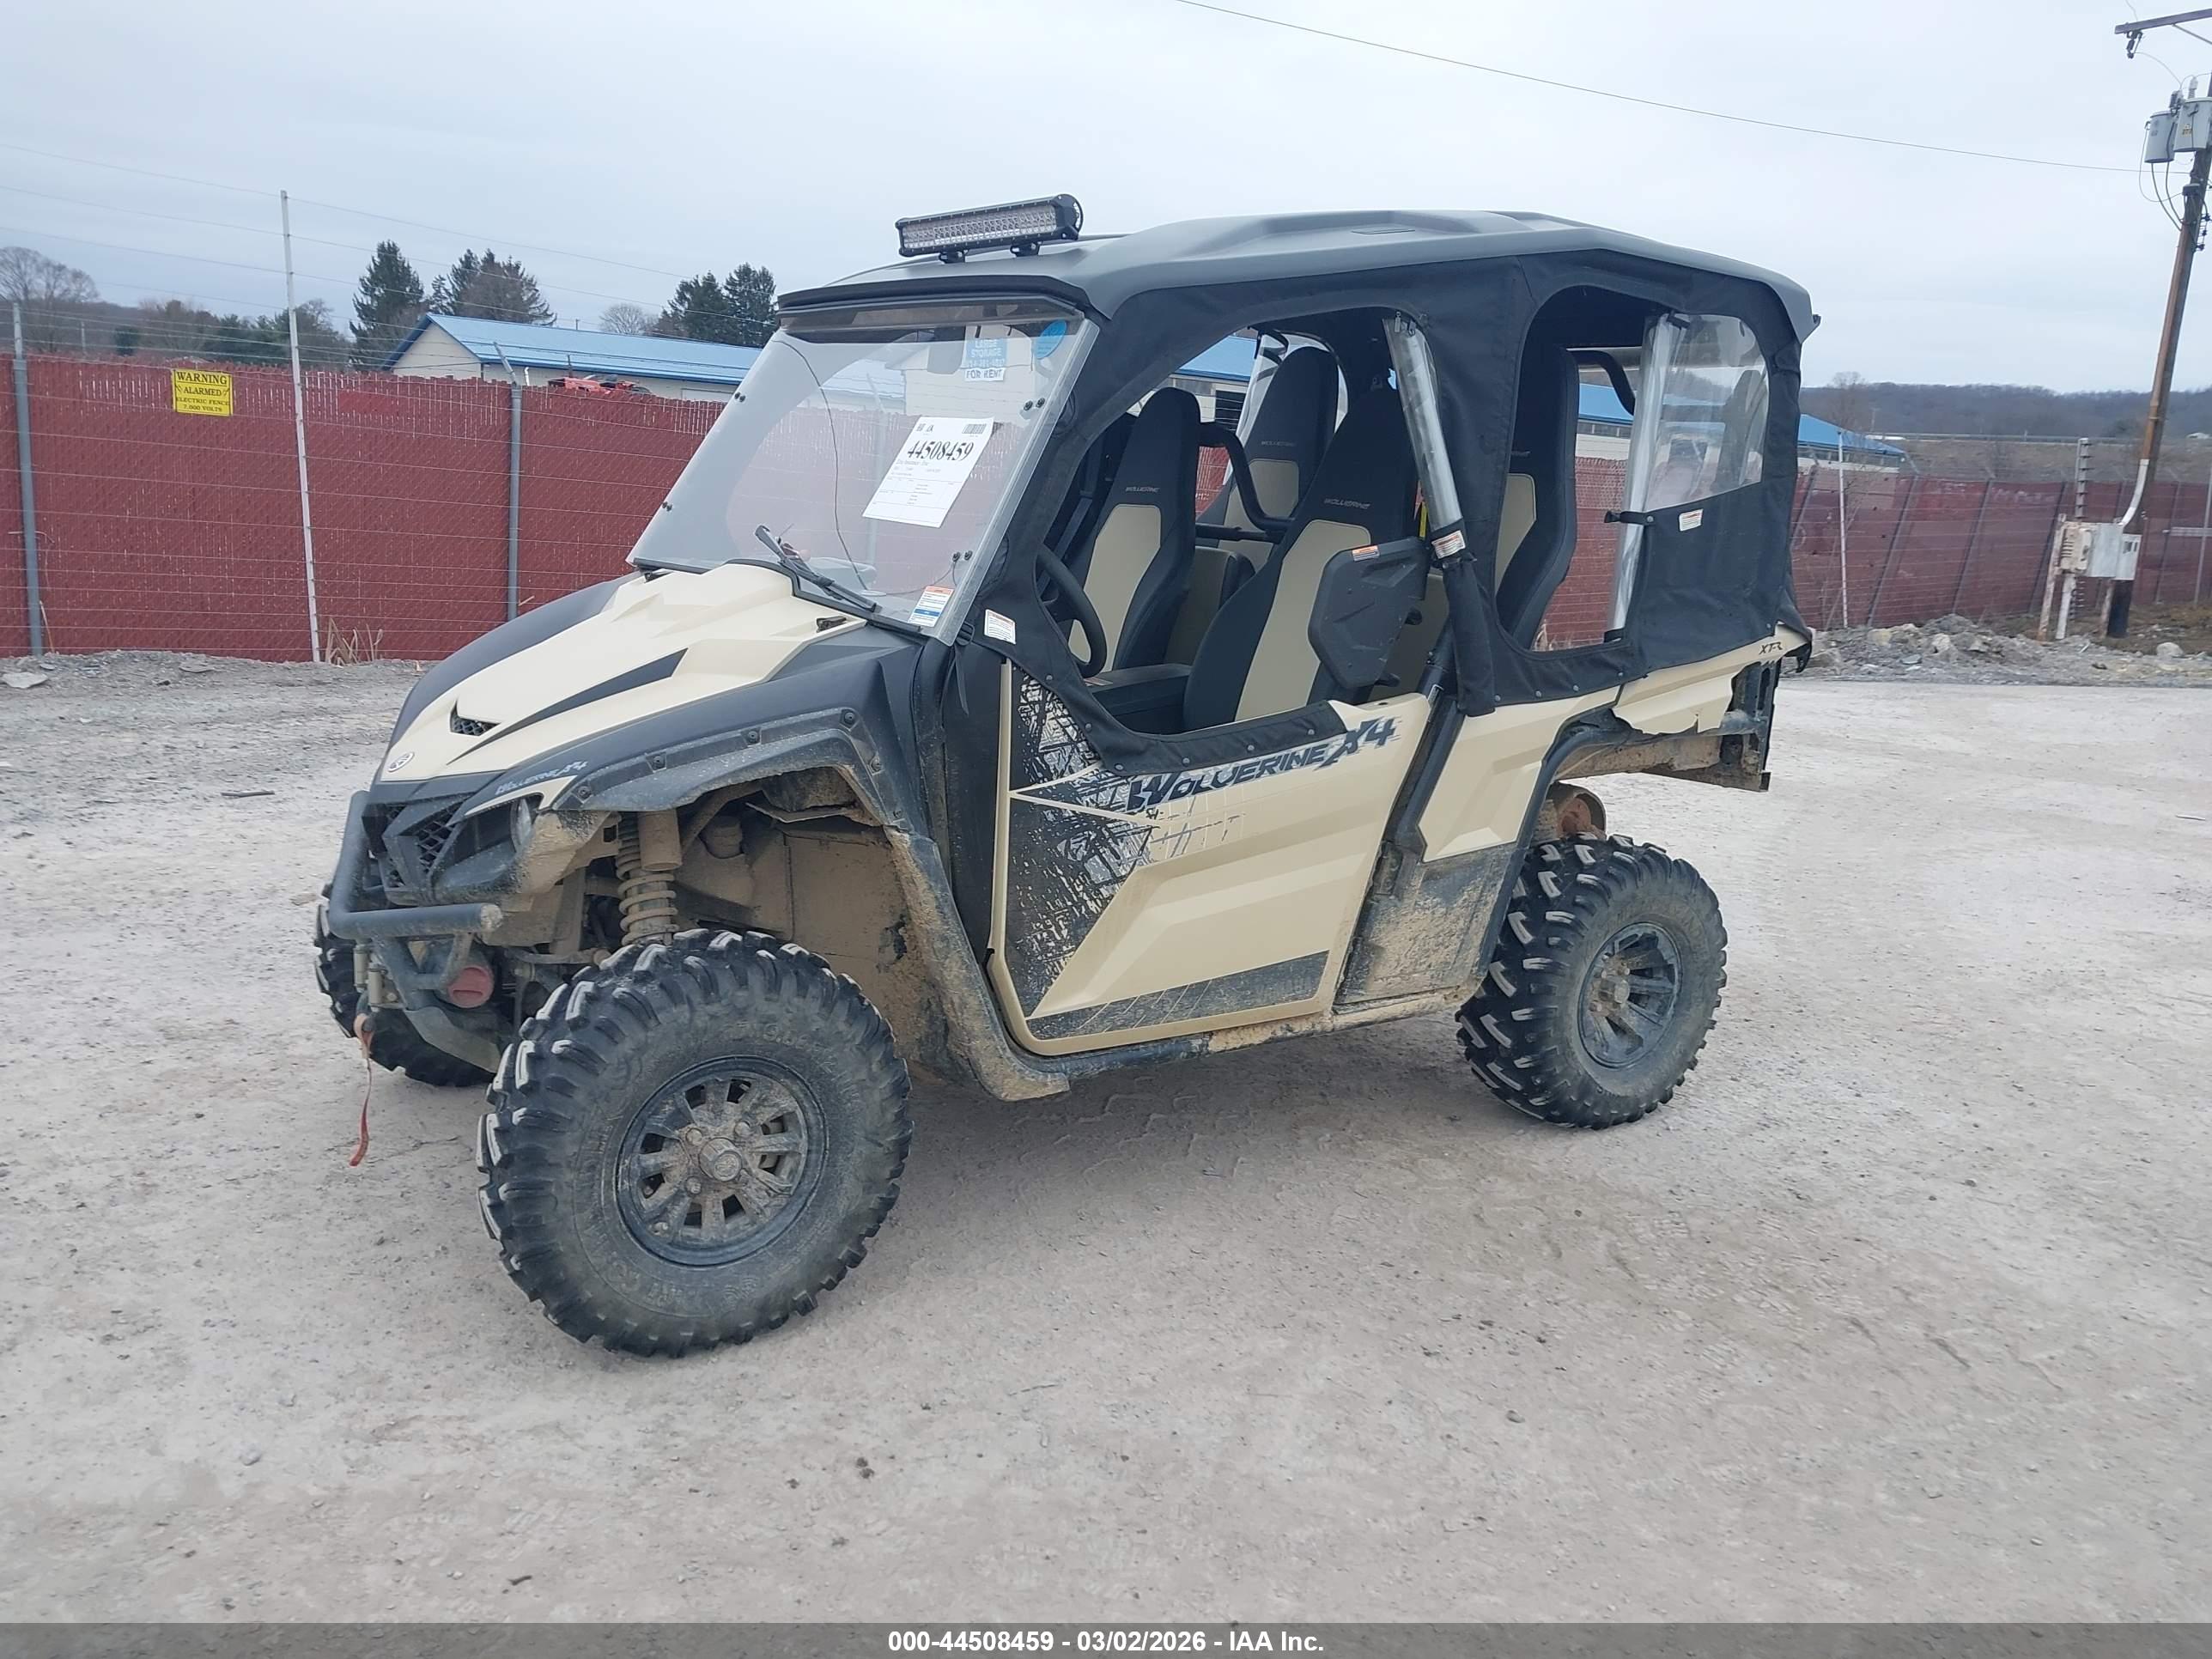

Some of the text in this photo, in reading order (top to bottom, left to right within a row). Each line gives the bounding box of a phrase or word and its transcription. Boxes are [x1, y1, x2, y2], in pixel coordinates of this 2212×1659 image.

[177, 372, 228, 385] WARNING
[966, 368, 1003, 379] FOR RENT
[183, 386, 222, 397] ALARMED
[907, 440, 975, 461] 44508459
[1127, 717, 1397, 811] WOLVERINE X4
